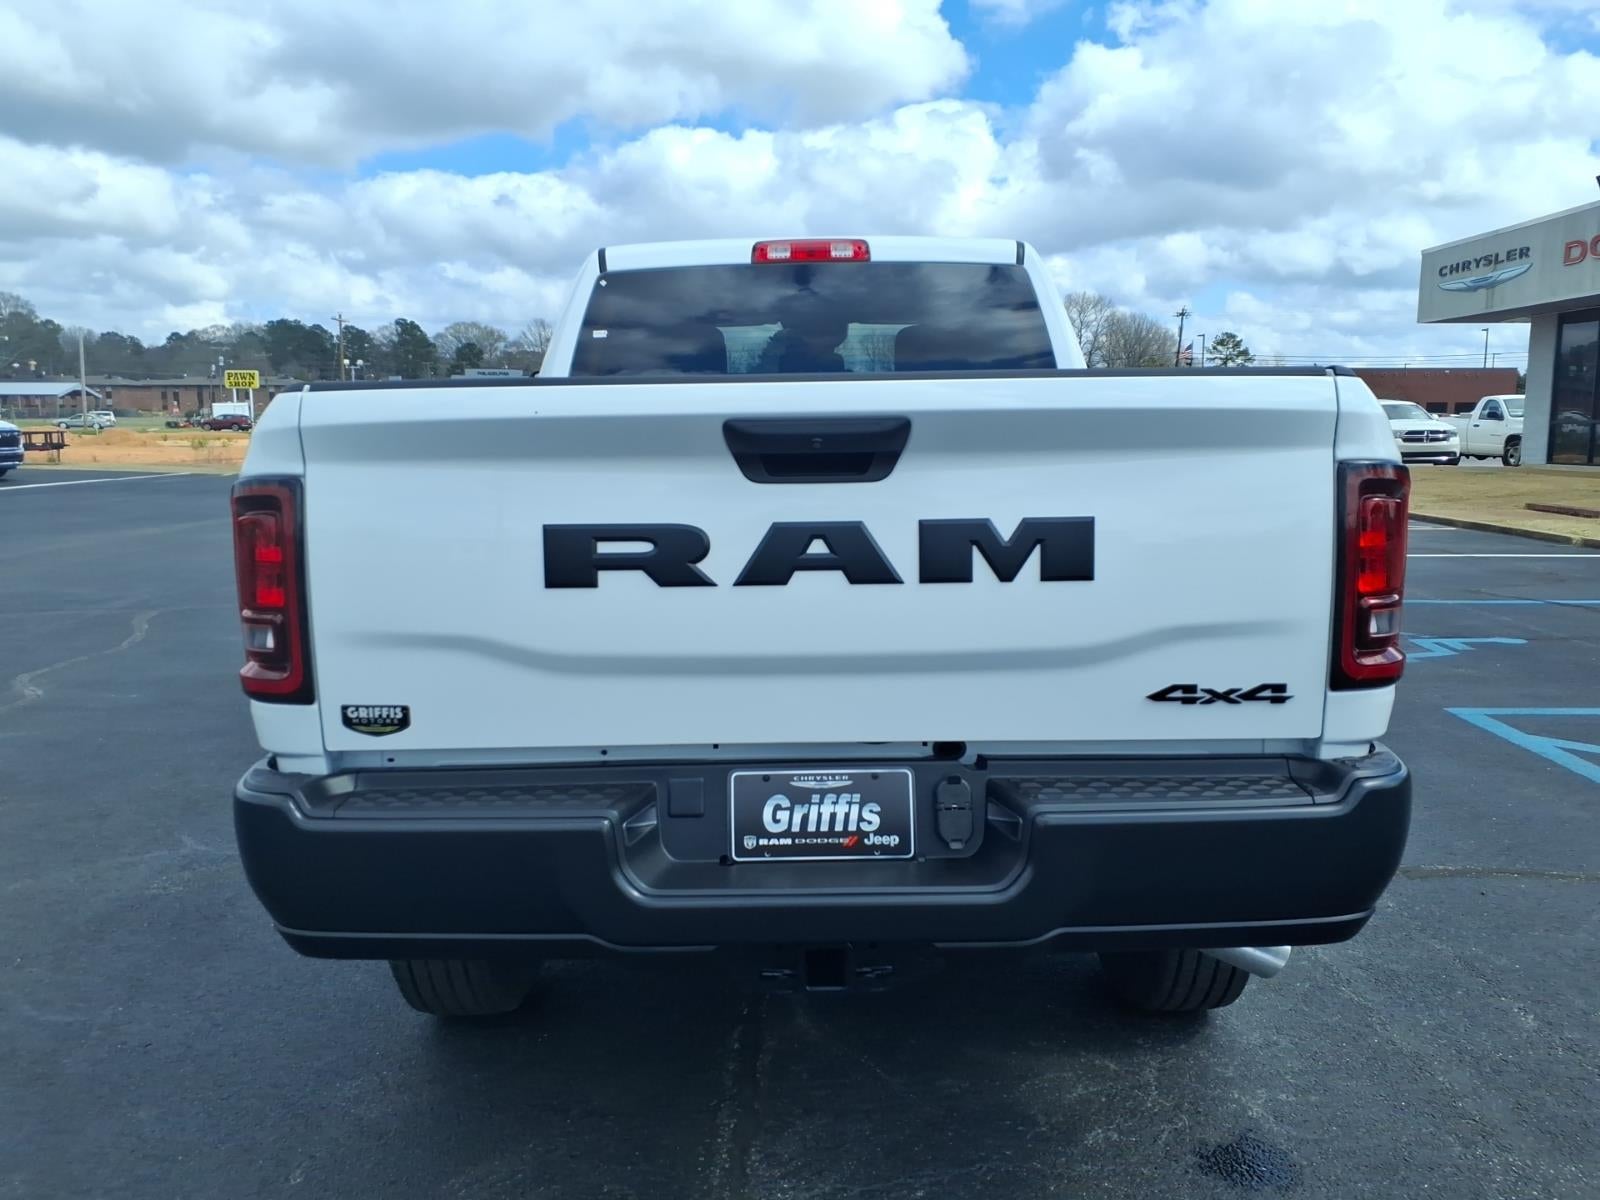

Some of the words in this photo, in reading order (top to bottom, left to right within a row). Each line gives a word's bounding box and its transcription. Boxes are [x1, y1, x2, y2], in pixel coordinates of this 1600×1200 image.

[1438, 246, 1531, 277] CHRYSLER
[226, 372, 256, 381] PAWN
[543, 516, 1096, 588] RAM
[1145, 683, 1295, 704] 4x4
[346, 707, 403, 718] GRIFFIS
[762, 793, 882, 833] Griffis
[758, 837, 792, 845] RAM
[864, 833, 900, 847] Jeep
